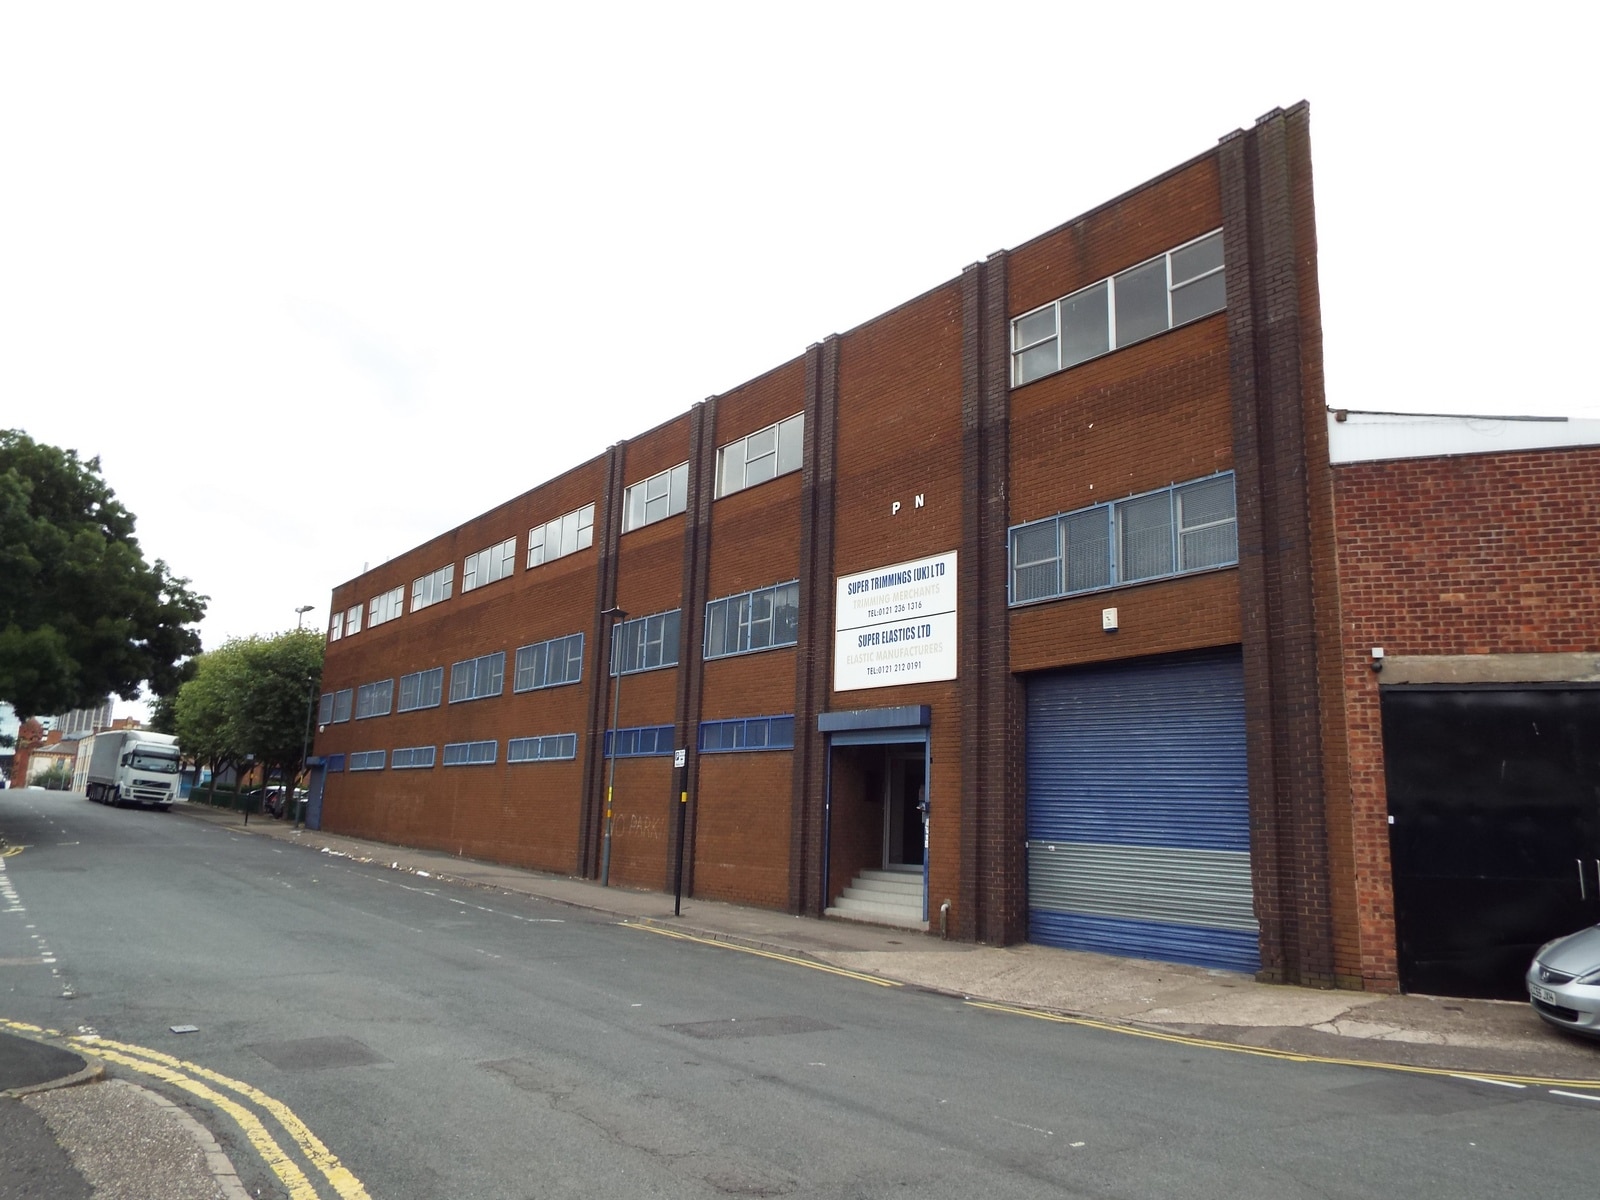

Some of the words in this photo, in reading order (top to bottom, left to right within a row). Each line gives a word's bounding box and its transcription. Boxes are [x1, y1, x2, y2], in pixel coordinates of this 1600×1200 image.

[848, 579, 869, 595] SUPER
[871, 570, 912, 590] TRIMMINGS
[853, 594, 891, 610] TRIMMING
[892, 583, 940, 603] MERCHANTS
[894, 604, 906, 613] 236
[907, 600, 923, 611] 1316
[858, 633, 880, 648] SUPER
[881, 626, 916, 644] ELASTICS
[917, 624, 931, 638] LTD
[846, 652, 875, 665] ELASTIC
[876, 642, 944, 661] MANUFACTURERS
[894, 663, 906, 673] 212
[906, 661, 922, 671] 0191
